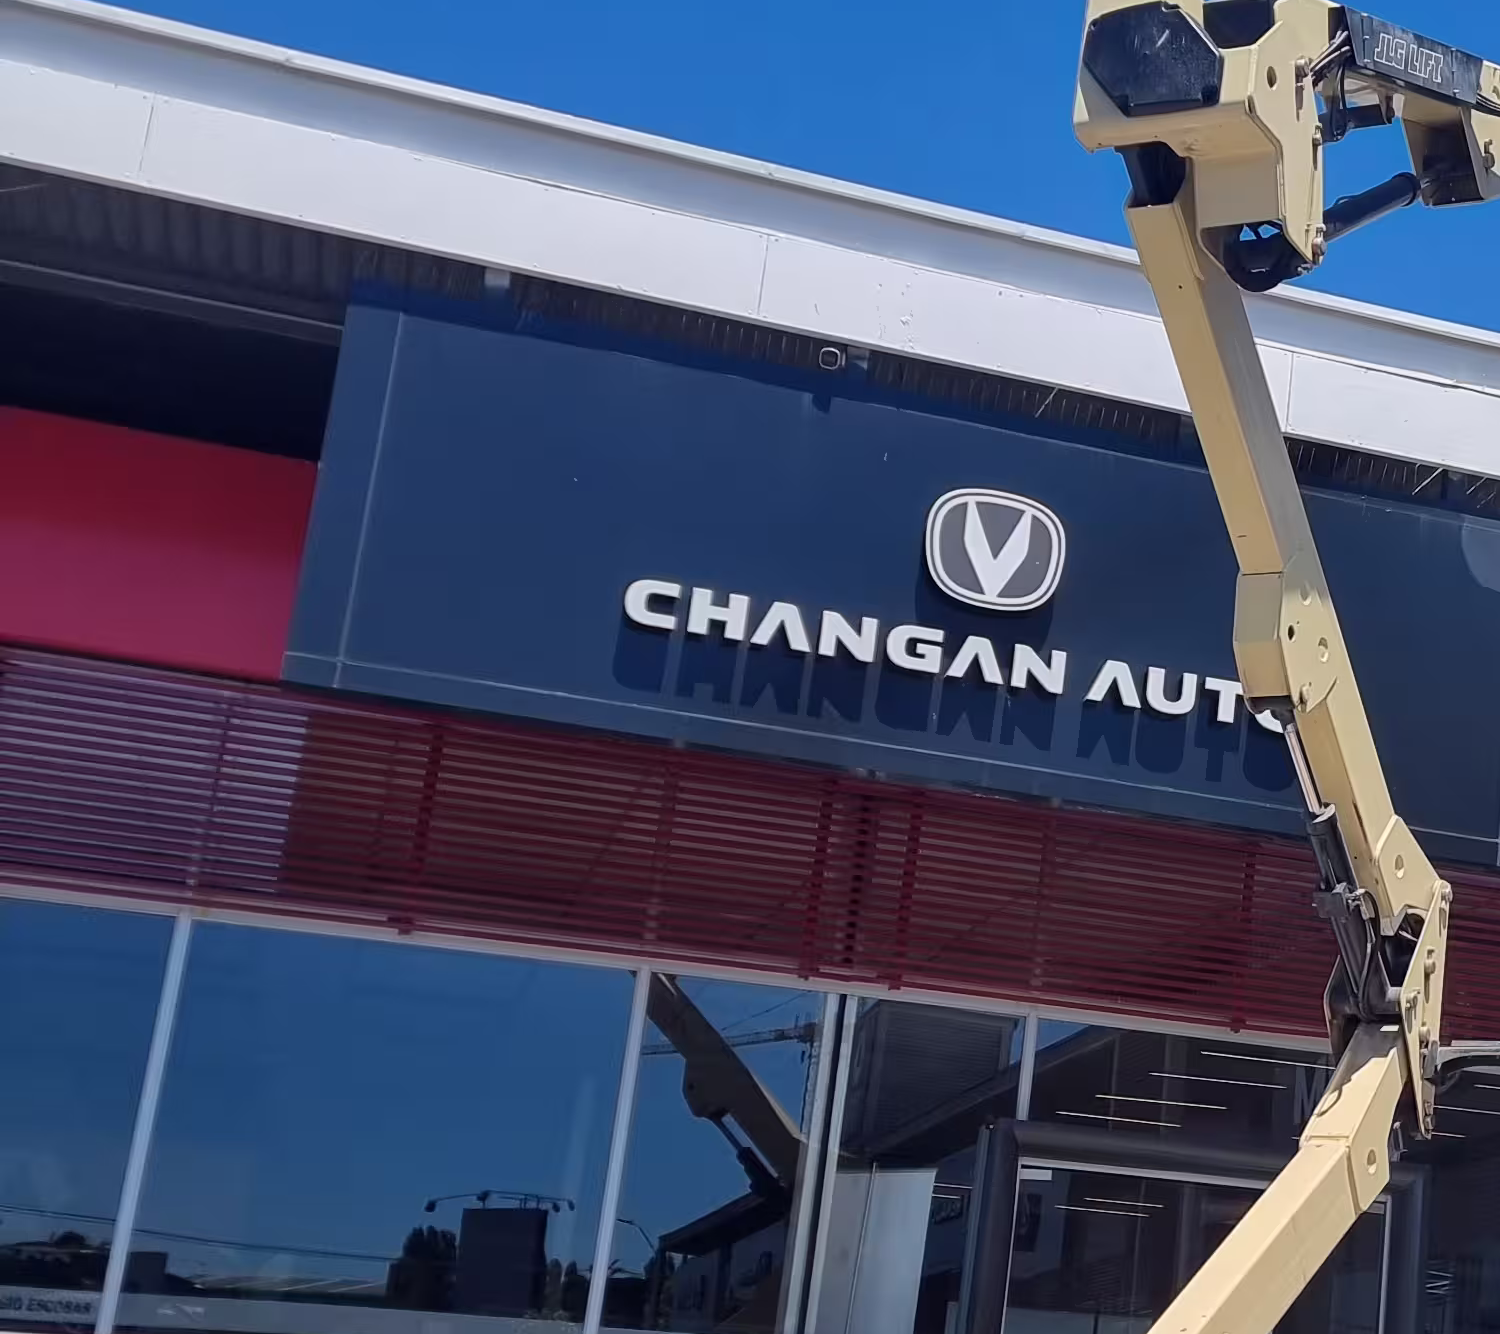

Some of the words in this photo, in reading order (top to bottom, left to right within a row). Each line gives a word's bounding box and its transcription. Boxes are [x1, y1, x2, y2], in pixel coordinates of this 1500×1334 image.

[1374, 32, 1406, 70] JLG
[1408, 43, 1443, 83] LIFT
[623, 578, 1067, 696] CHANGAN
[1083, 659, 1284, 734] AUT
